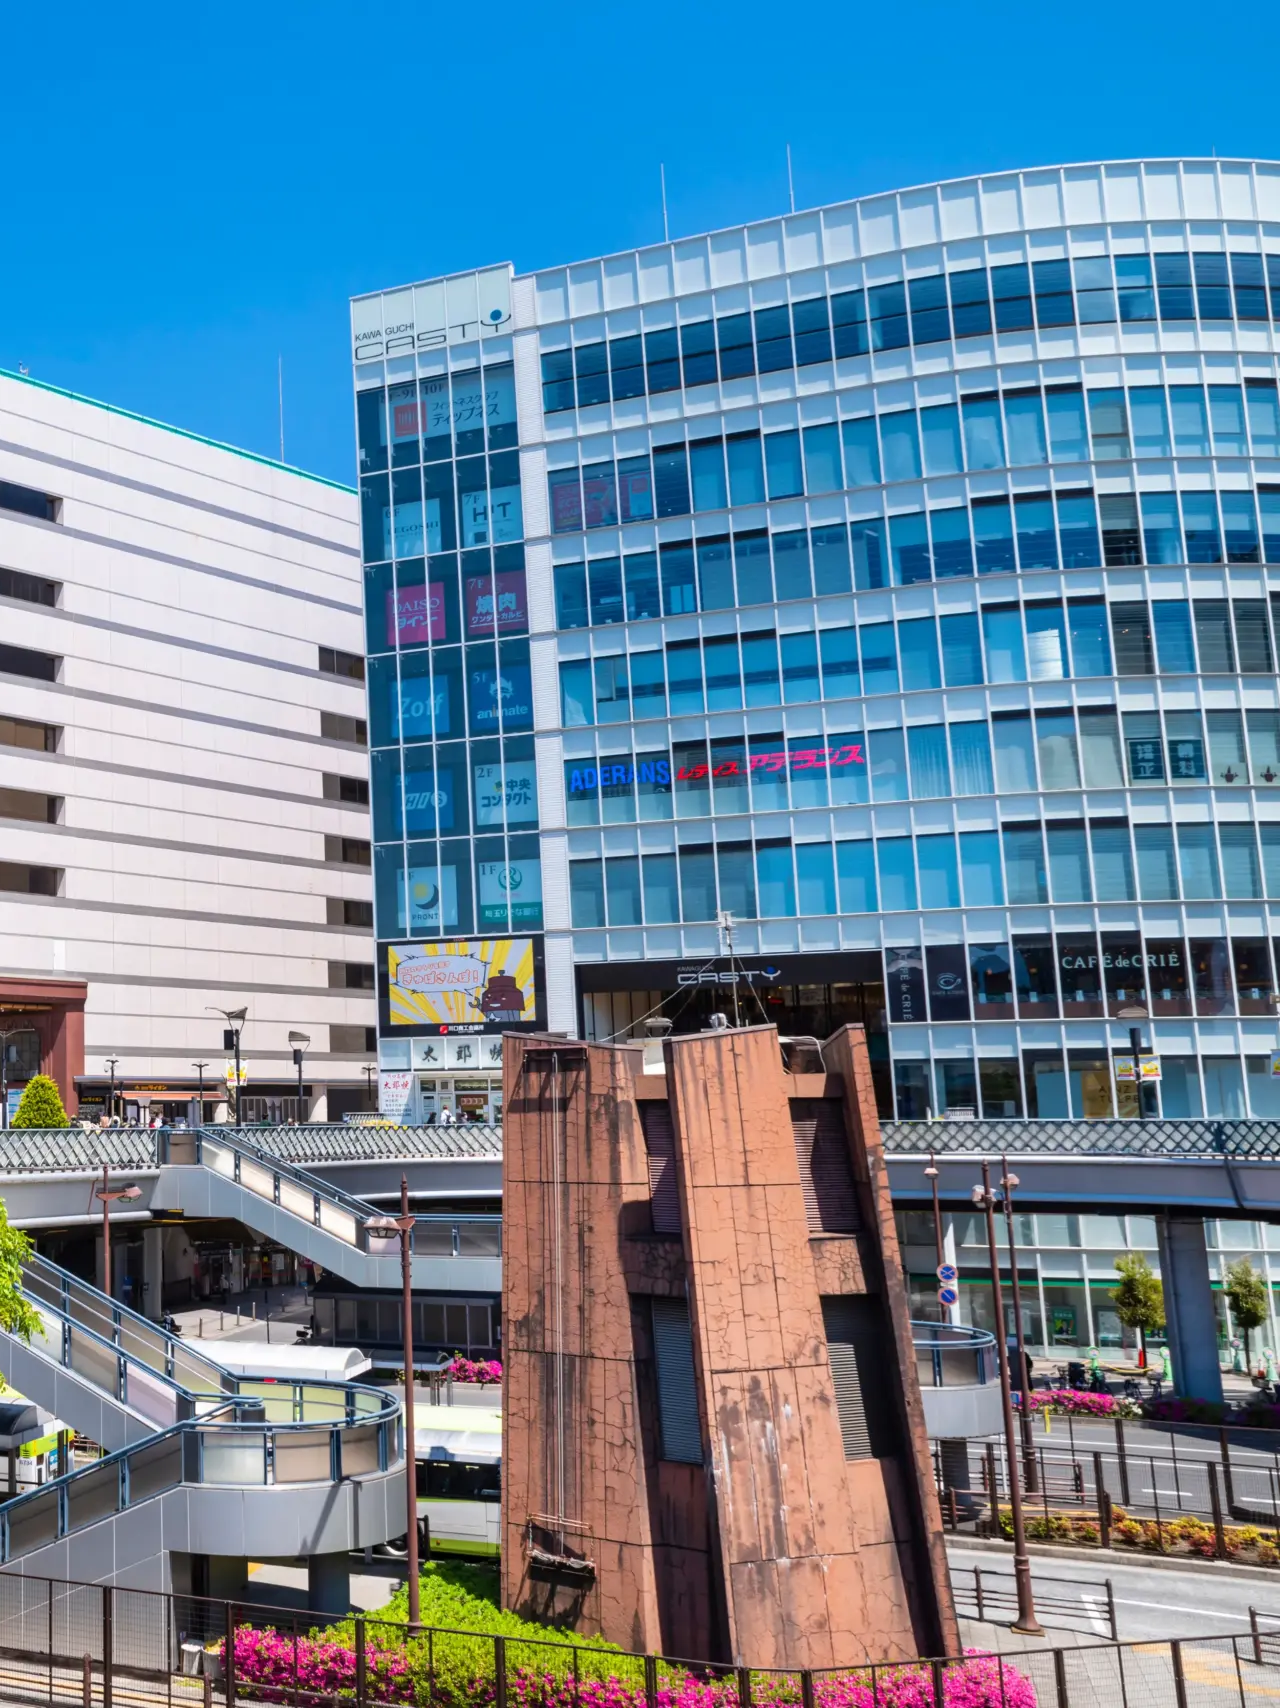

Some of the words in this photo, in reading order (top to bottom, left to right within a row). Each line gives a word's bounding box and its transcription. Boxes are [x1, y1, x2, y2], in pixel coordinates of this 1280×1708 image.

[355, 310, 511, 361] CASTY
[475, 592, 517, 614] 焼肉
[395, 693, 445, 720] Zoff
[477, 703, 528, 720] animate
[506, 778, 532, 791] 中央
[570, 759, 670, 793] ADERANS
[481, 794, 532, 808] コンタクト
[411, 912, 441, 922] PRONT
[1061, 952, 1113, 969] CAFÉ
[1115, 954, 1130, 968] de
[1131, 951, 1180, 968] CRIÉ
[677, 966, 781, 985] CASTY
